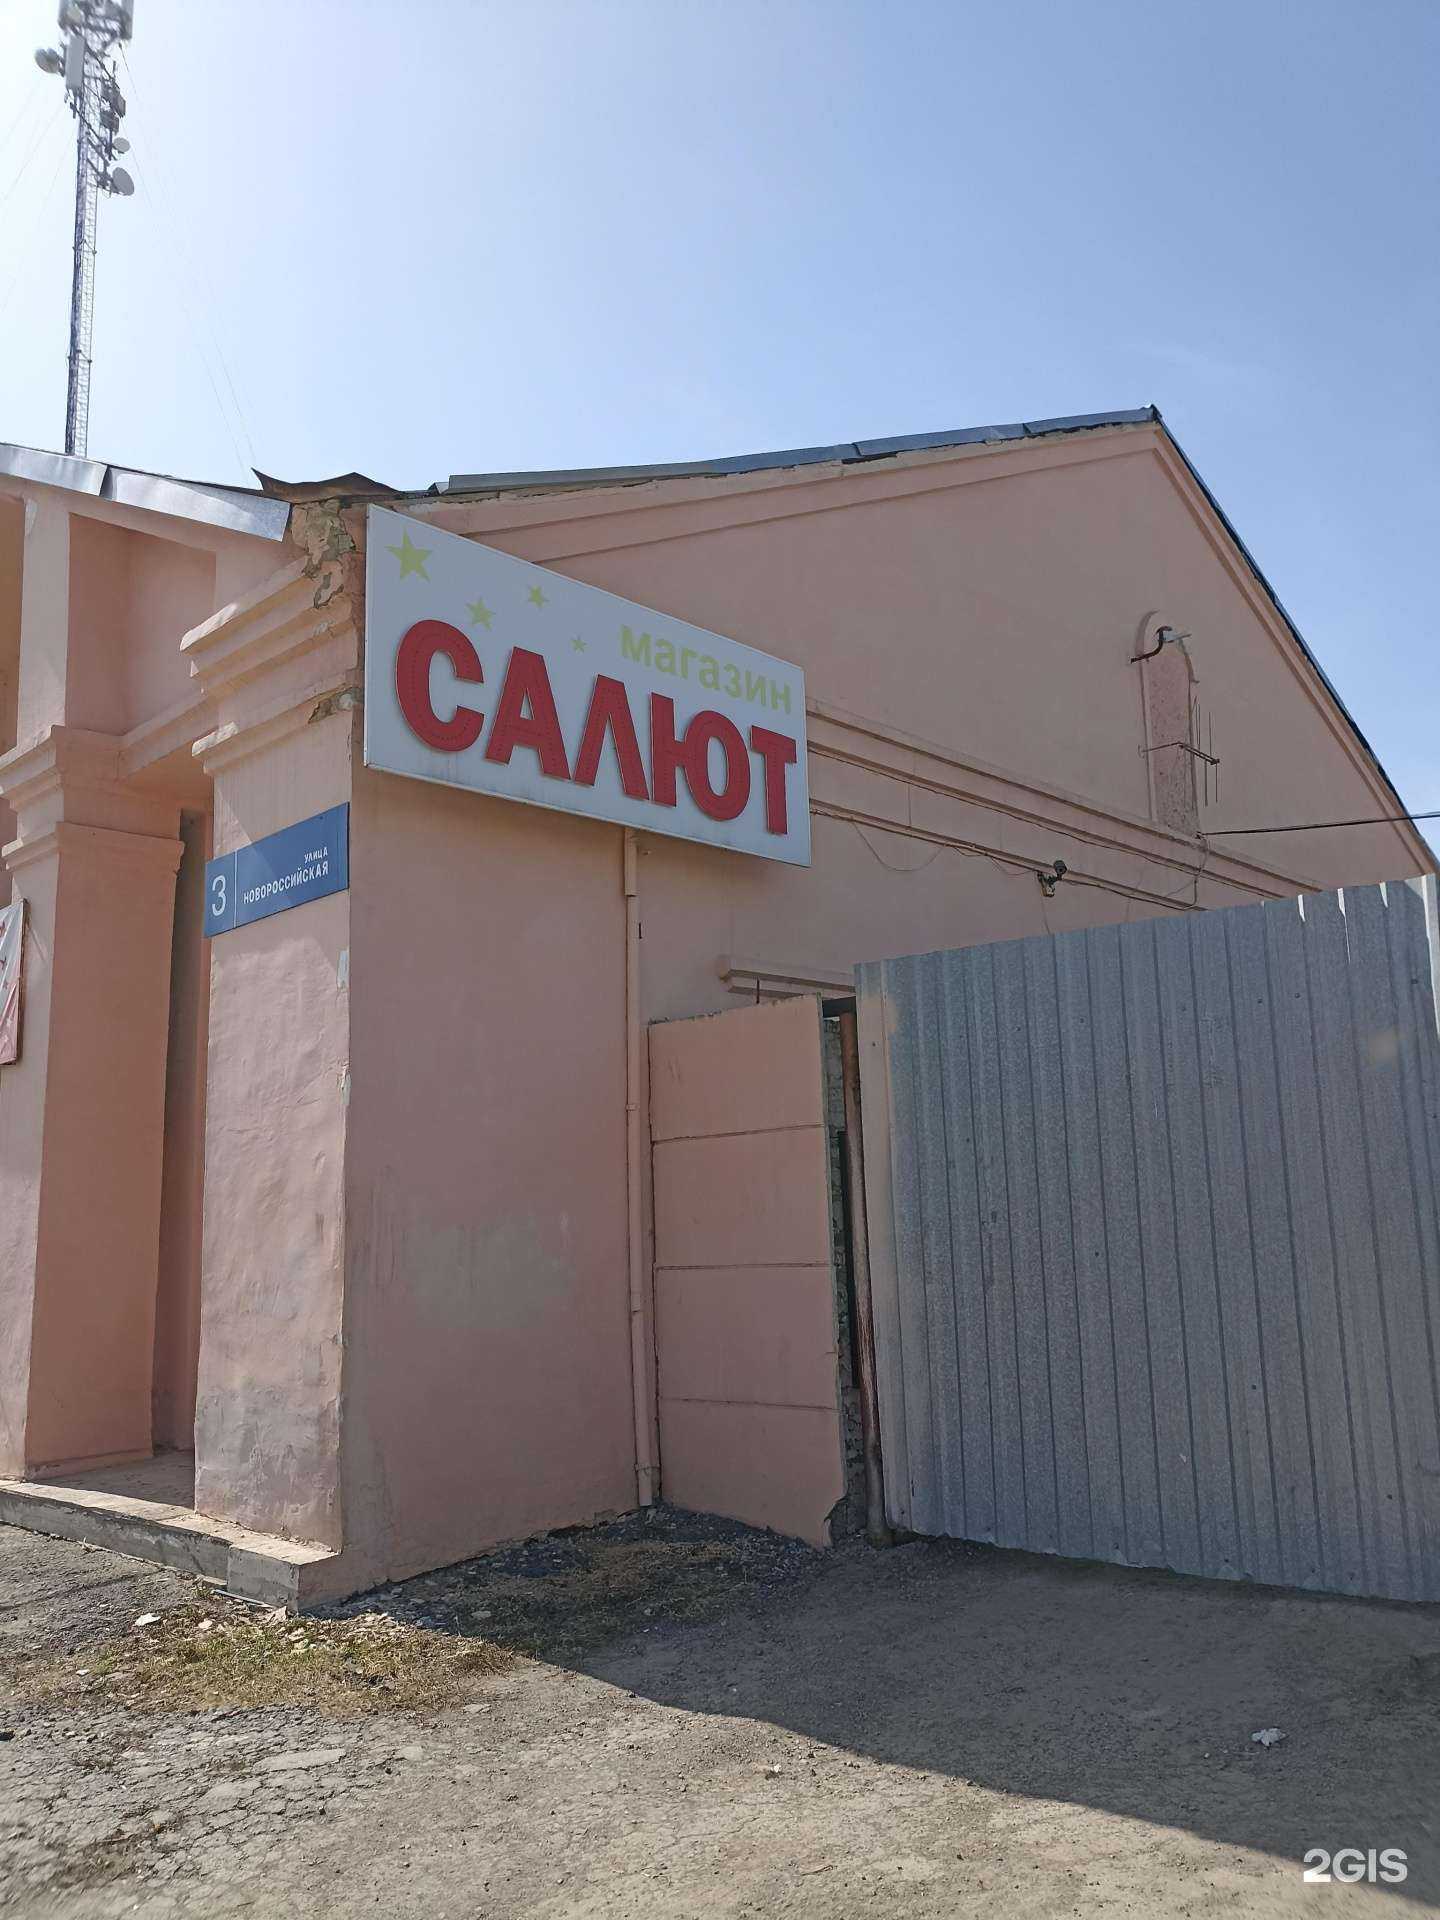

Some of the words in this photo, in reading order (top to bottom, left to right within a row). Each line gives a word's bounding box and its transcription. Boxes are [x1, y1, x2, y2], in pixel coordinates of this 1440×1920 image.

[620, 624, 792, 714] магазин
[396, 619, 797, 835] САЛЮТ
[304, 846, 328, 864] УЛИЦА
[211, 875, 227, 917] 3
[243, 861, 329, 904] НОВОРОССИЙСКАЯ
